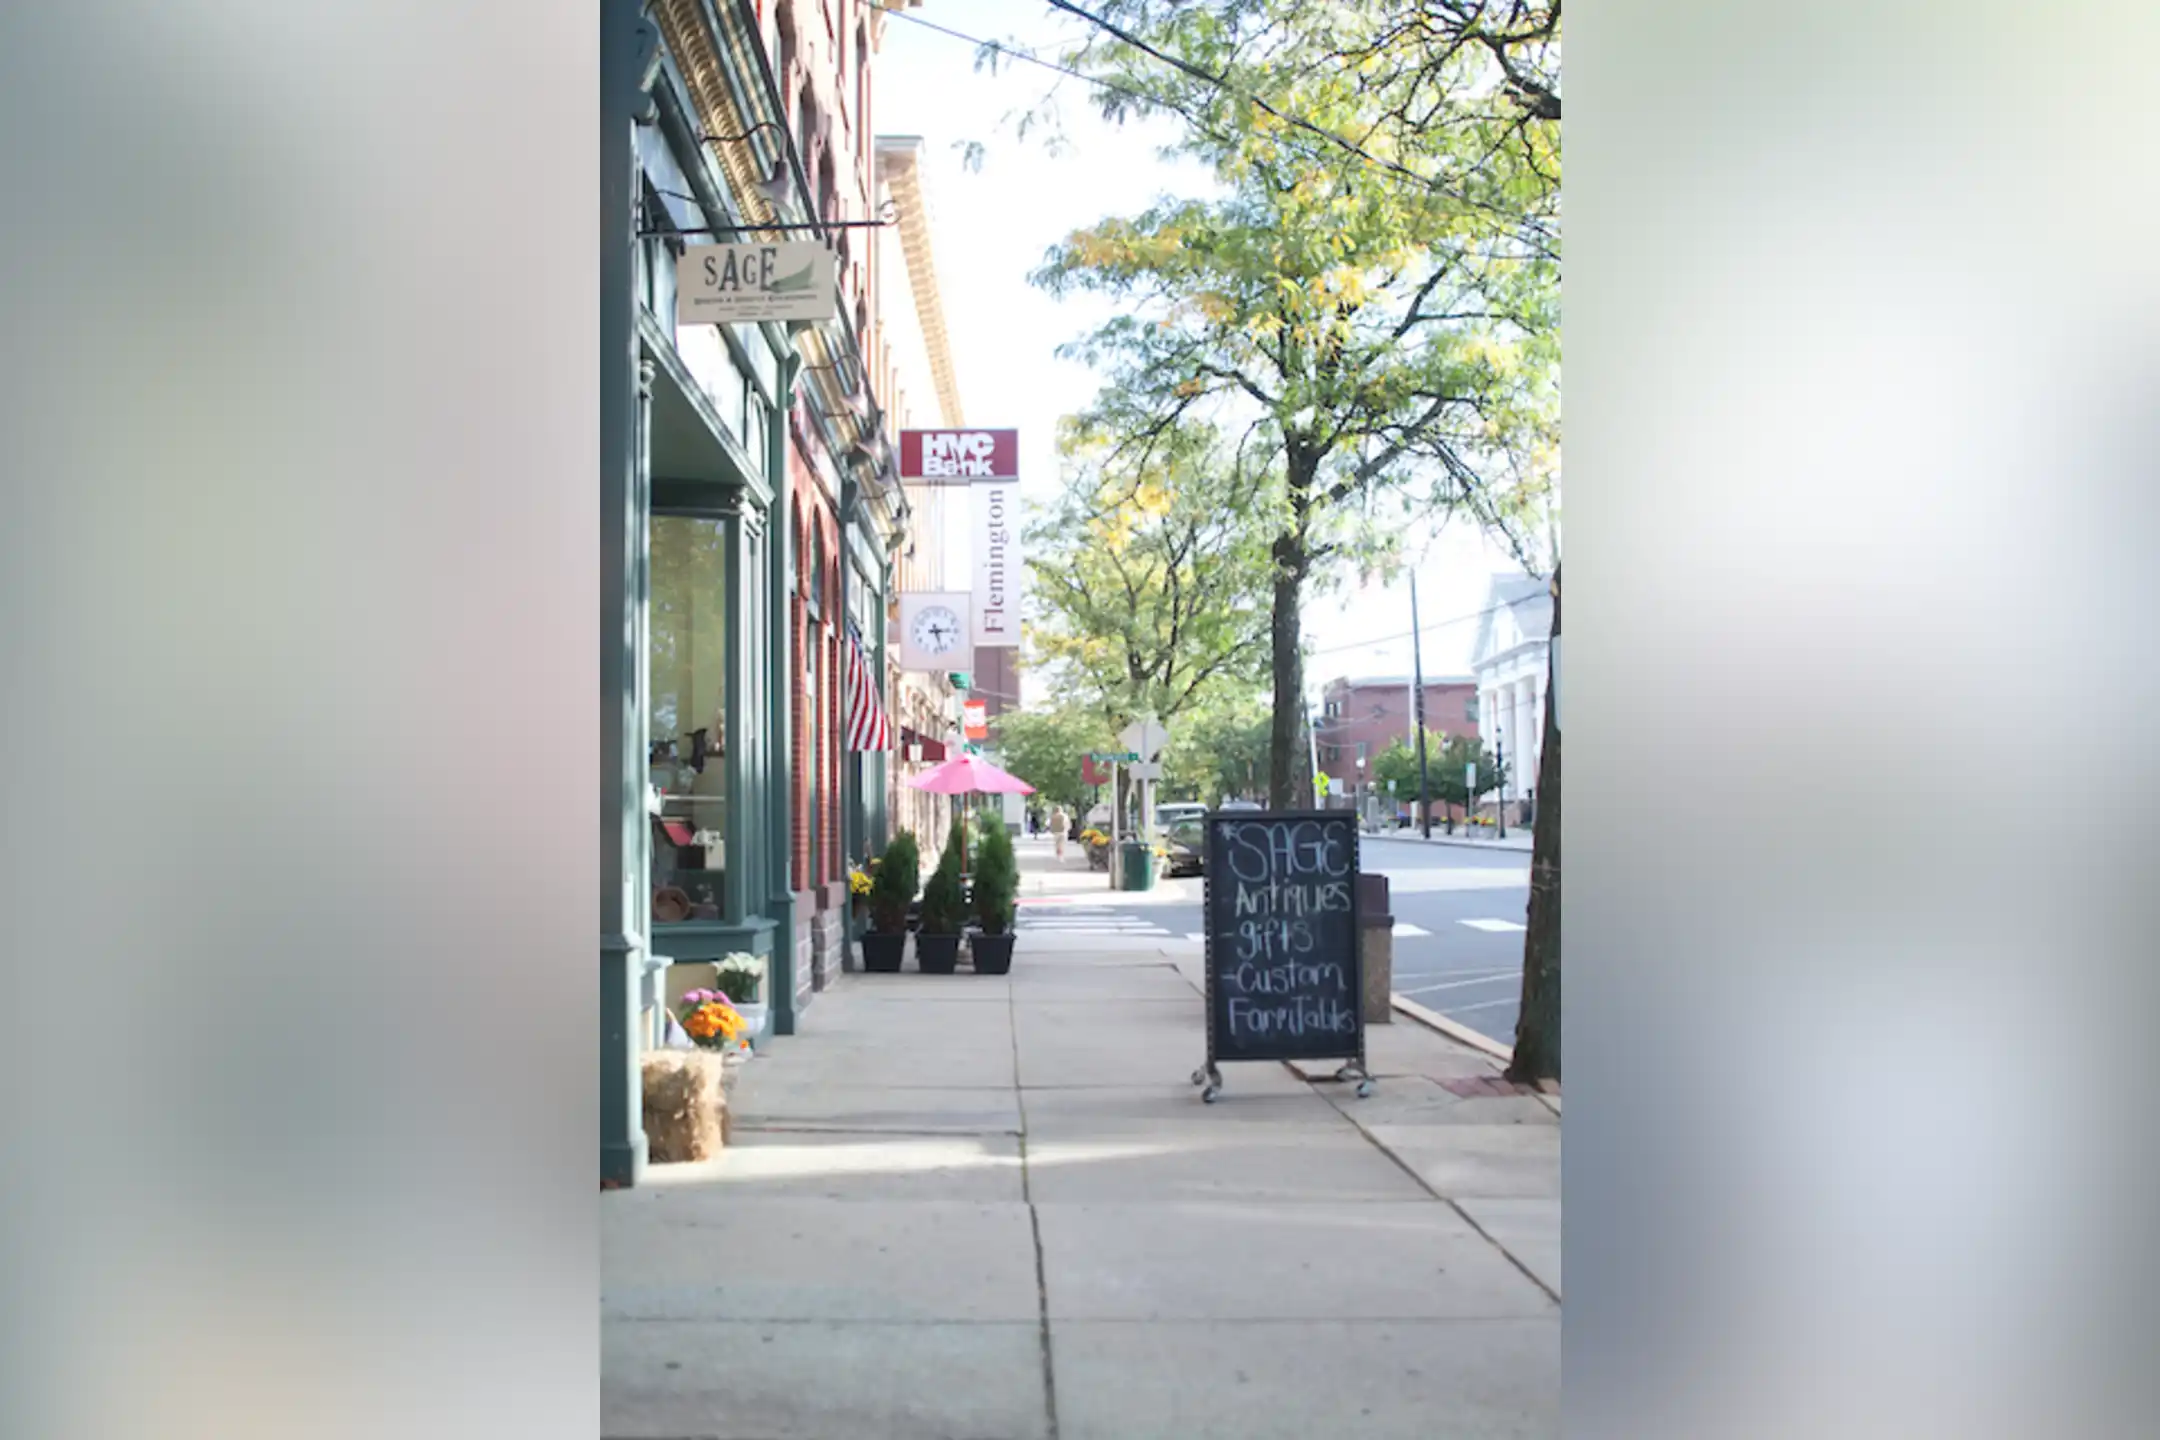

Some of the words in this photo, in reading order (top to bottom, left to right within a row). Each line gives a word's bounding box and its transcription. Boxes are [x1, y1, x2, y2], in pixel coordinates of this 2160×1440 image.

[704, 248, 777, 291] SAGE
[922, 456, 995, 476] Bank
[984, 490, 1010, 633] Flemington
[1235, 876, 1352, 918] Antiques
